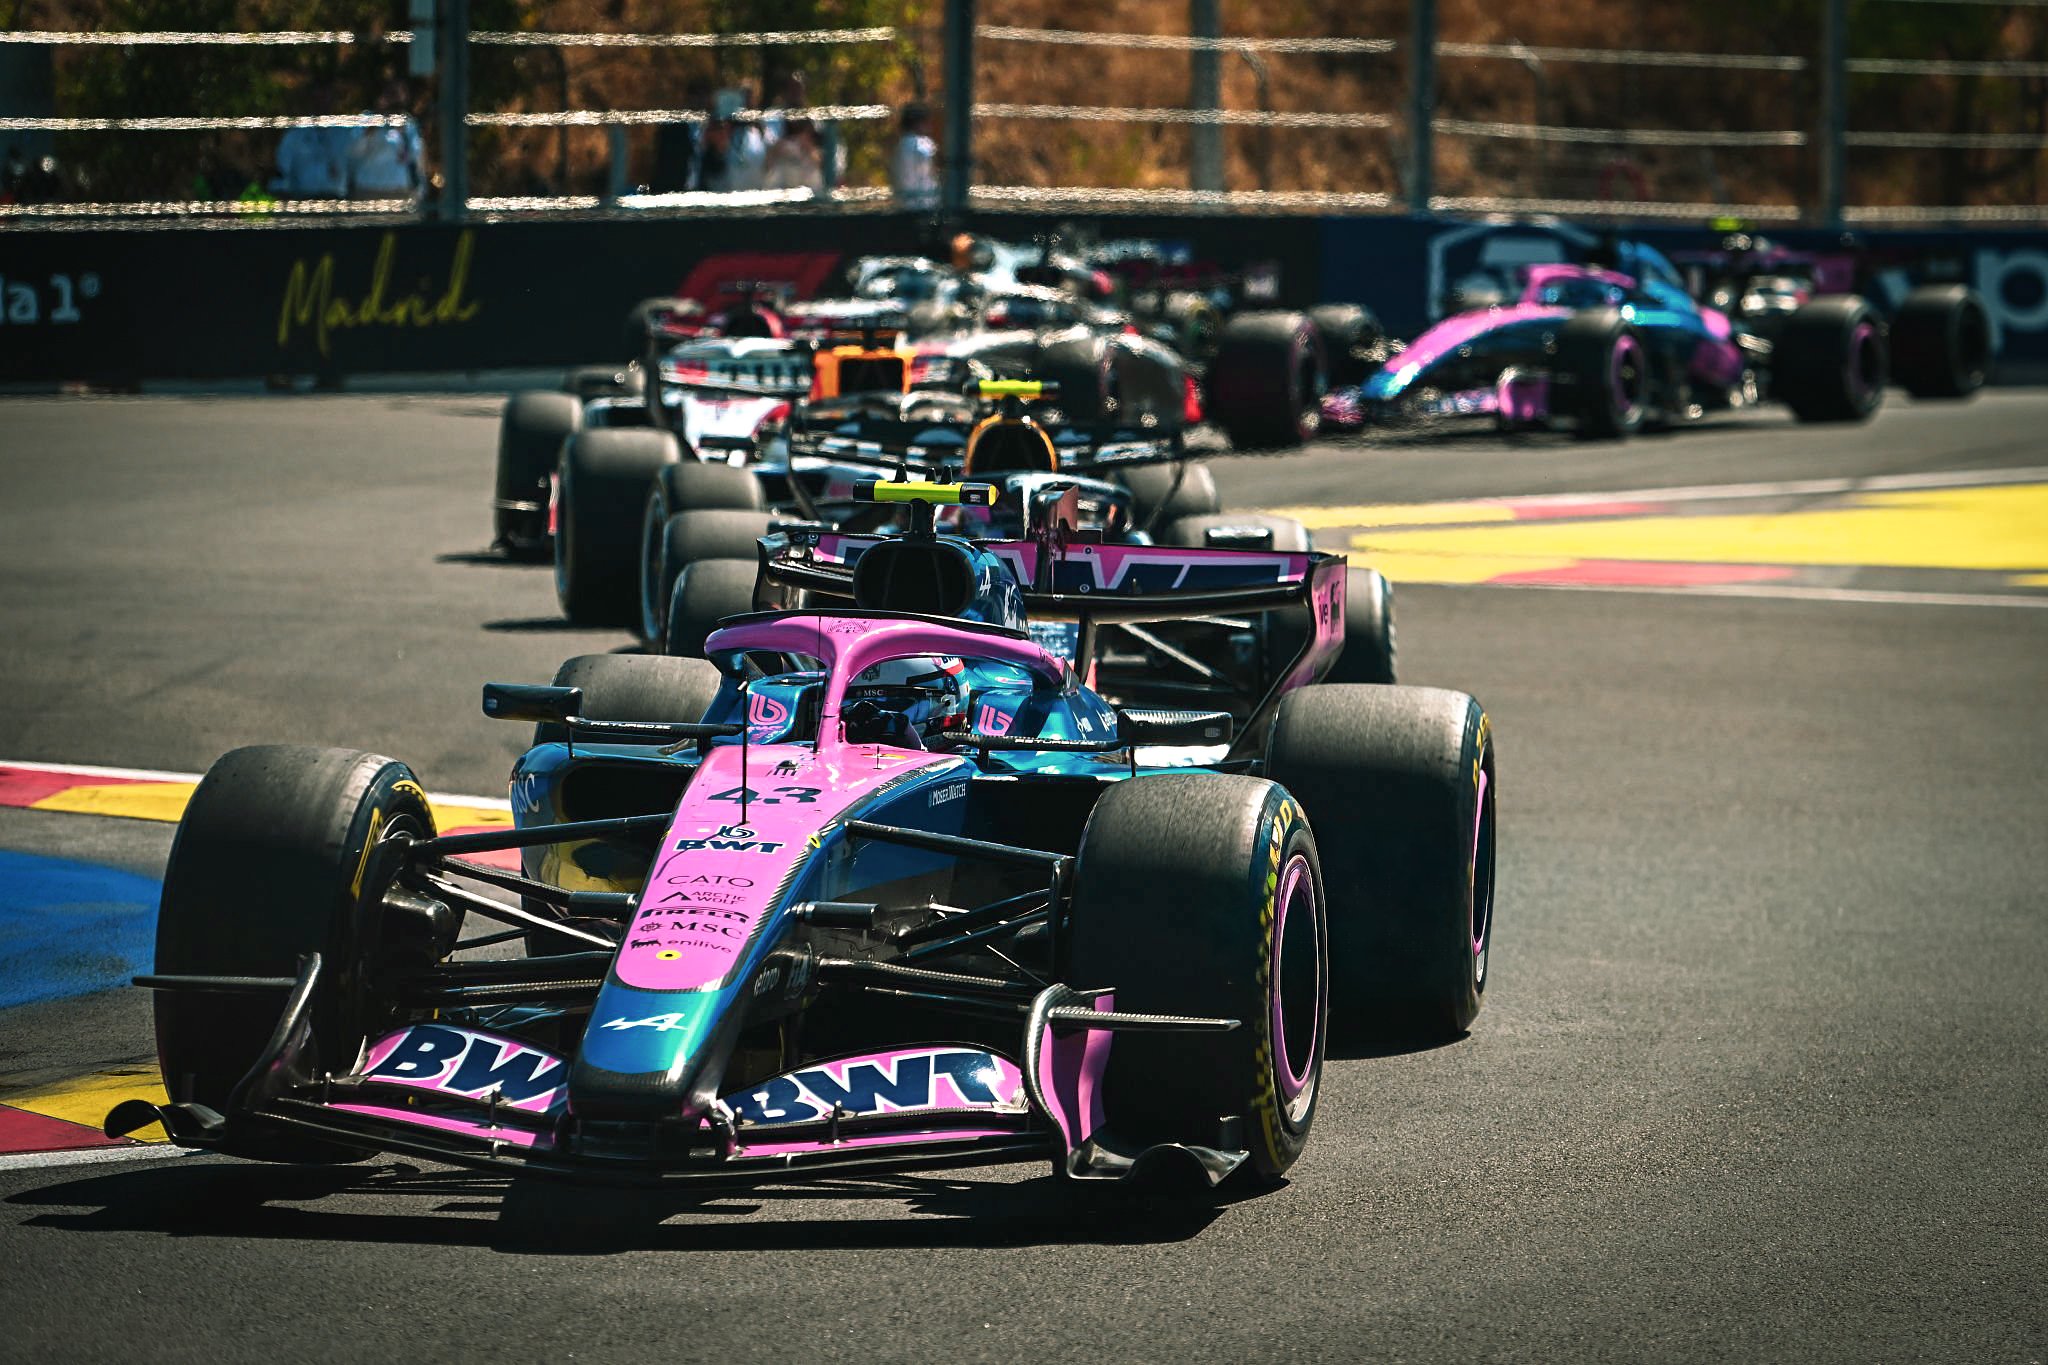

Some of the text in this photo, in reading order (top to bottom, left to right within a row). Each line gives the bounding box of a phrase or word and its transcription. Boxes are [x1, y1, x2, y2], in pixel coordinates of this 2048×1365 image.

[277, 227, 481, 357] Madrid
[708, 786, 822, 805] 43
[674, 839, 785, 854] BWT
[667, 875, 754, 888] CATO
[691, 891, 747, 902] ARCTIC
[697, 896, 741, 905] WOLF
[640, 905, 751, 924] PIRELLI
[670, 921, 744, 940] MSC
[667, 940, 732, 953] enilive
[369, 1025, 568, 1102] BW
[723, 1050, 1002, 1124] BWT
